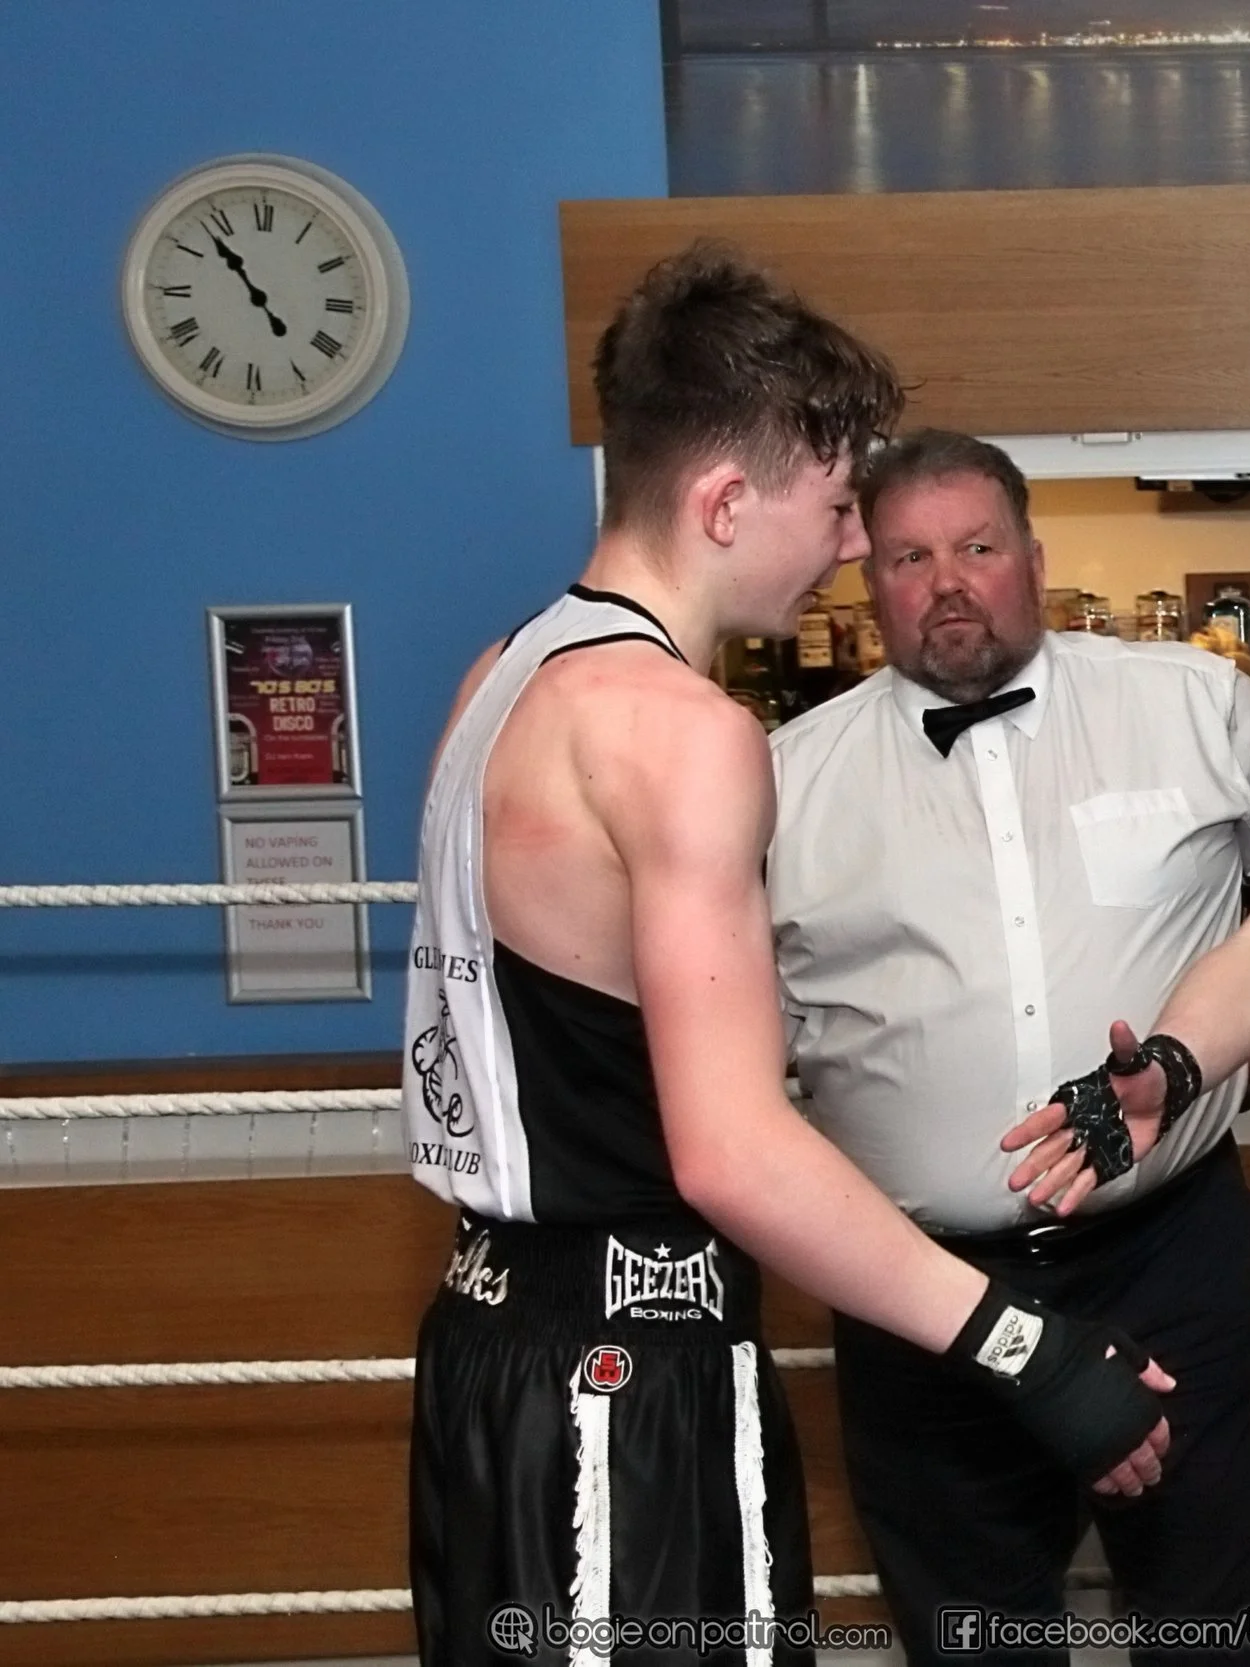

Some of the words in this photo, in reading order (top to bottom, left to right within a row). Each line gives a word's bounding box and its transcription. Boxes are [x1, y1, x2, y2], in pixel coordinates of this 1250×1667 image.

[269, 697, 315, 713] RETRO
[273, 715, 315, 731] DISCO
[245, 837, 265, 848] NO
[268, 836, 318, 848] VAPING
[246, 856, 309, 868] ALLOWED
[312, 855, 332, 868] ON
[249, 918, 292, 930] THANK
[297, 918, 324, 929] YOU
[605, 1234, 724, 1321] GEEZERS
[630, 1307, 702, 1321] BOXING
[988, 1315, 1018, 1364] adidas
